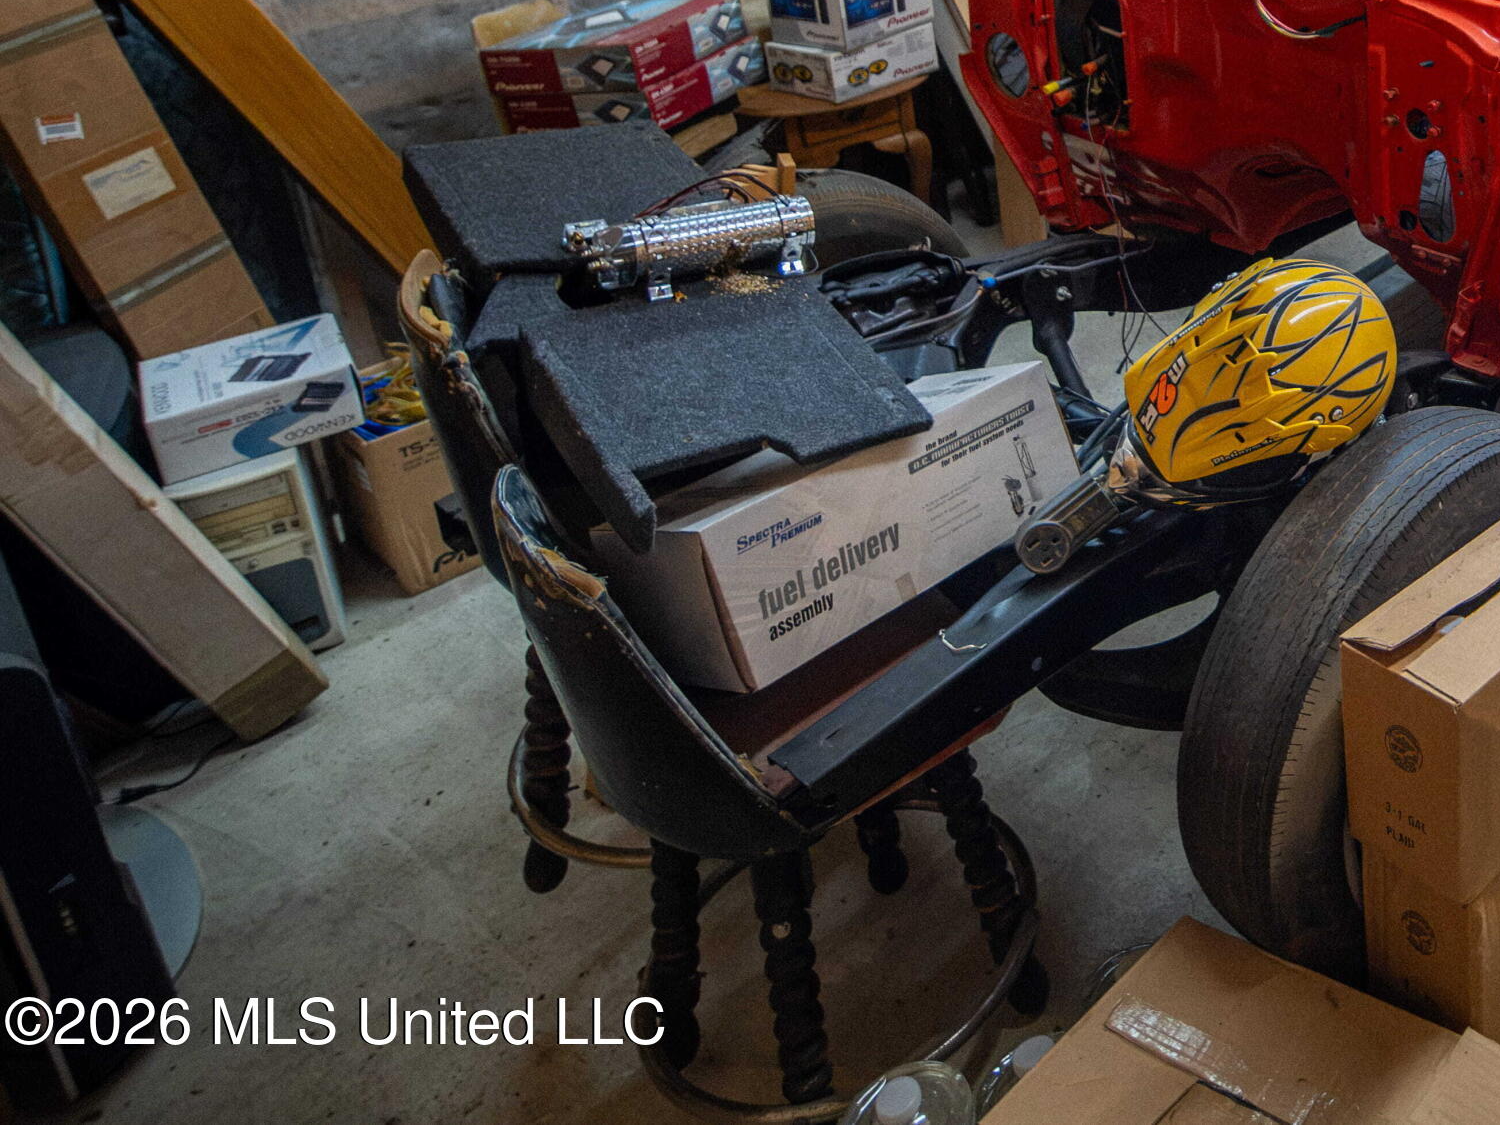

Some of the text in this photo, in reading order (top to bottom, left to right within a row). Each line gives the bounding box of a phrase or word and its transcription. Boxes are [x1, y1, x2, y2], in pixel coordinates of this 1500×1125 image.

[887, 7, 931, 28] Pioneer
[893, 59, 936, 78] Pioneer
[284, 413, 356, 442] KENWOOD
[925, 429, 958, 452] the brand
[969, 441, 982, 454] fuel
[983, 431, 1005, 446] system
[736, 518, 791, 552] SPECTRA
[771, 514, 823, 549] PREMIUM
[758, 522, 900, 620] fuel delivery
[769, 592, 834, 642] assembly
